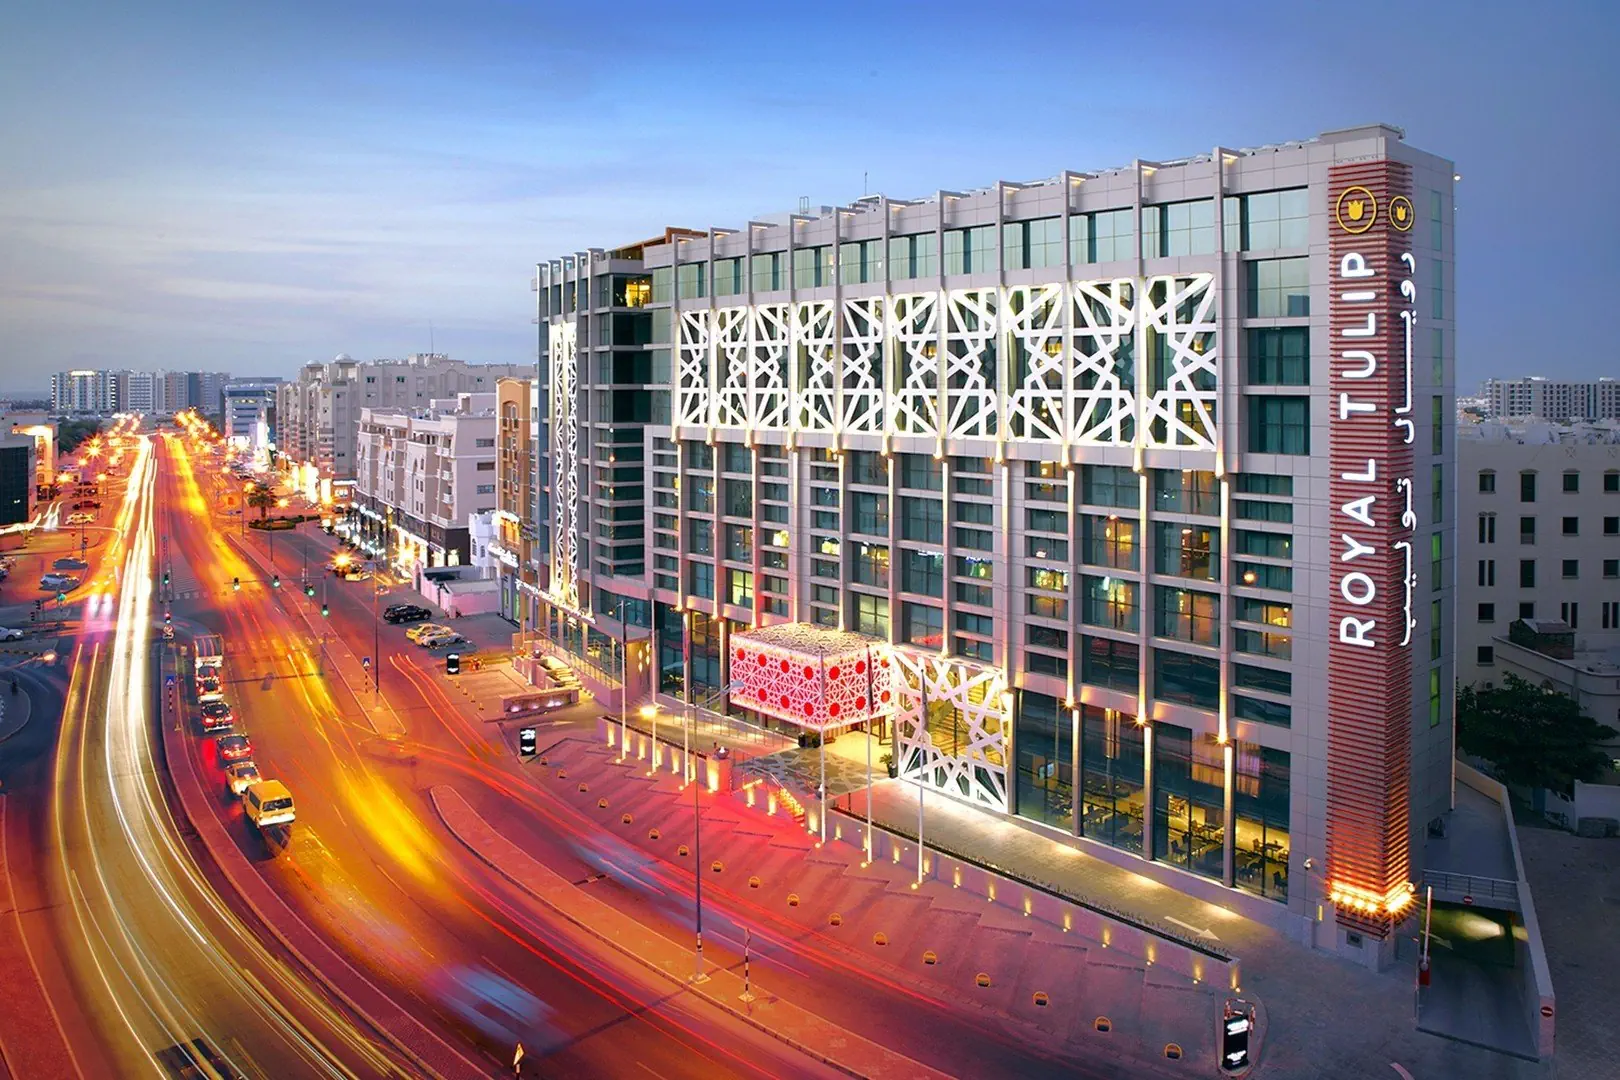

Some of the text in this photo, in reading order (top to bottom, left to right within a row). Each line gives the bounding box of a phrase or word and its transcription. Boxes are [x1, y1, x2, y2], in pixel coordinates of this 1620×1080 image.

[1340, 252, 1377, 648] ROYAL TULIP
[1394, 252, 1418, 647] رويال توليب
